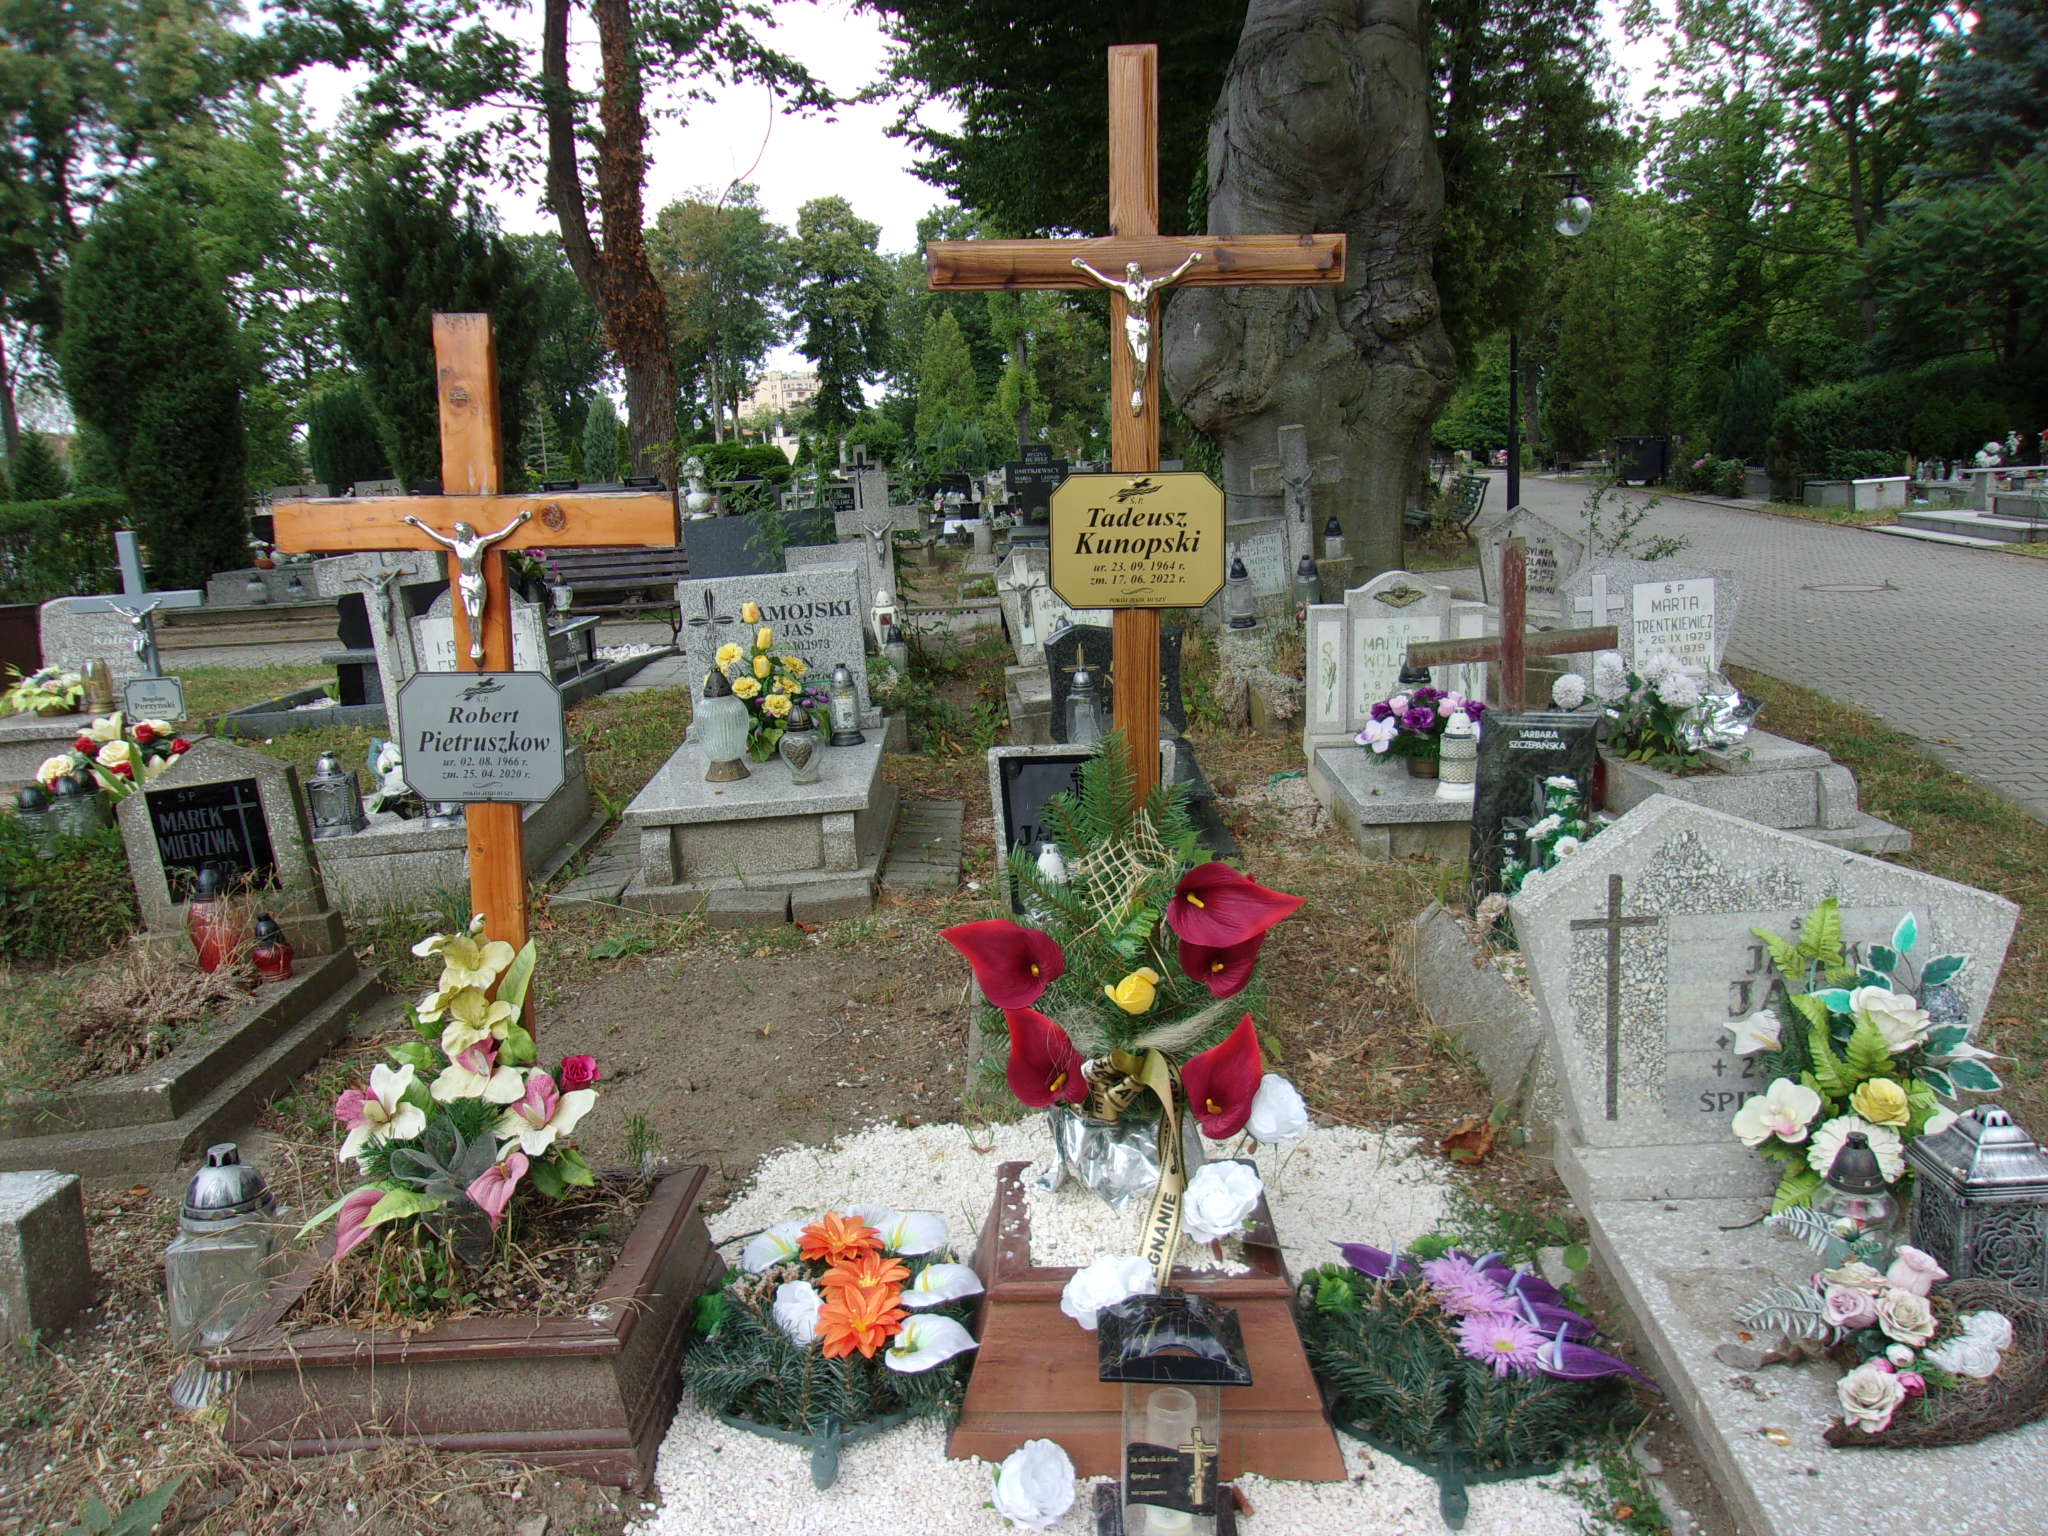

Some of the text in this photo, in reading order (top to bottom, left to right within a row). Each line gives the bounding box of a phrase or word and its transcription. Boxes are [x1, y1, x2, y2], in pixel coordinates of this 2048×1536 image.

[1088, 507, 1188, 528] Tadeusz
[1074, 531, 1201, 560] Kunopski
[1093, 561, 1186, 572] ur. 23. 09. 1964 r.
[1090, 574, 1186, 586] zm. 17. 06. 2022 r.
[1677, 584, 1685, 592] P
[740, 600, 853, 624] AMOJSKI
[1651, 596, 1699, 613] MARTA
[1635, 614, 1713, 634] TRENTKIEWICZ
[1685, 631, 1712, 642] 1979
[448, 706, 520, 724] Robert
[418, 730, 550, 754] Pietruszkow
[443, 757, 528, 767] ur. 02. 08. 1966 r.
[442, 769, 531, 780] zm. 25. 04. 2020 r.
[158, 805, 225, 833] MAREK
[159, 828, 240, 861] MIERZWA
[1700, 1090, 1758, 1113] ŚPI
[1147, 1191, 1177, 1279] EGNANIE
